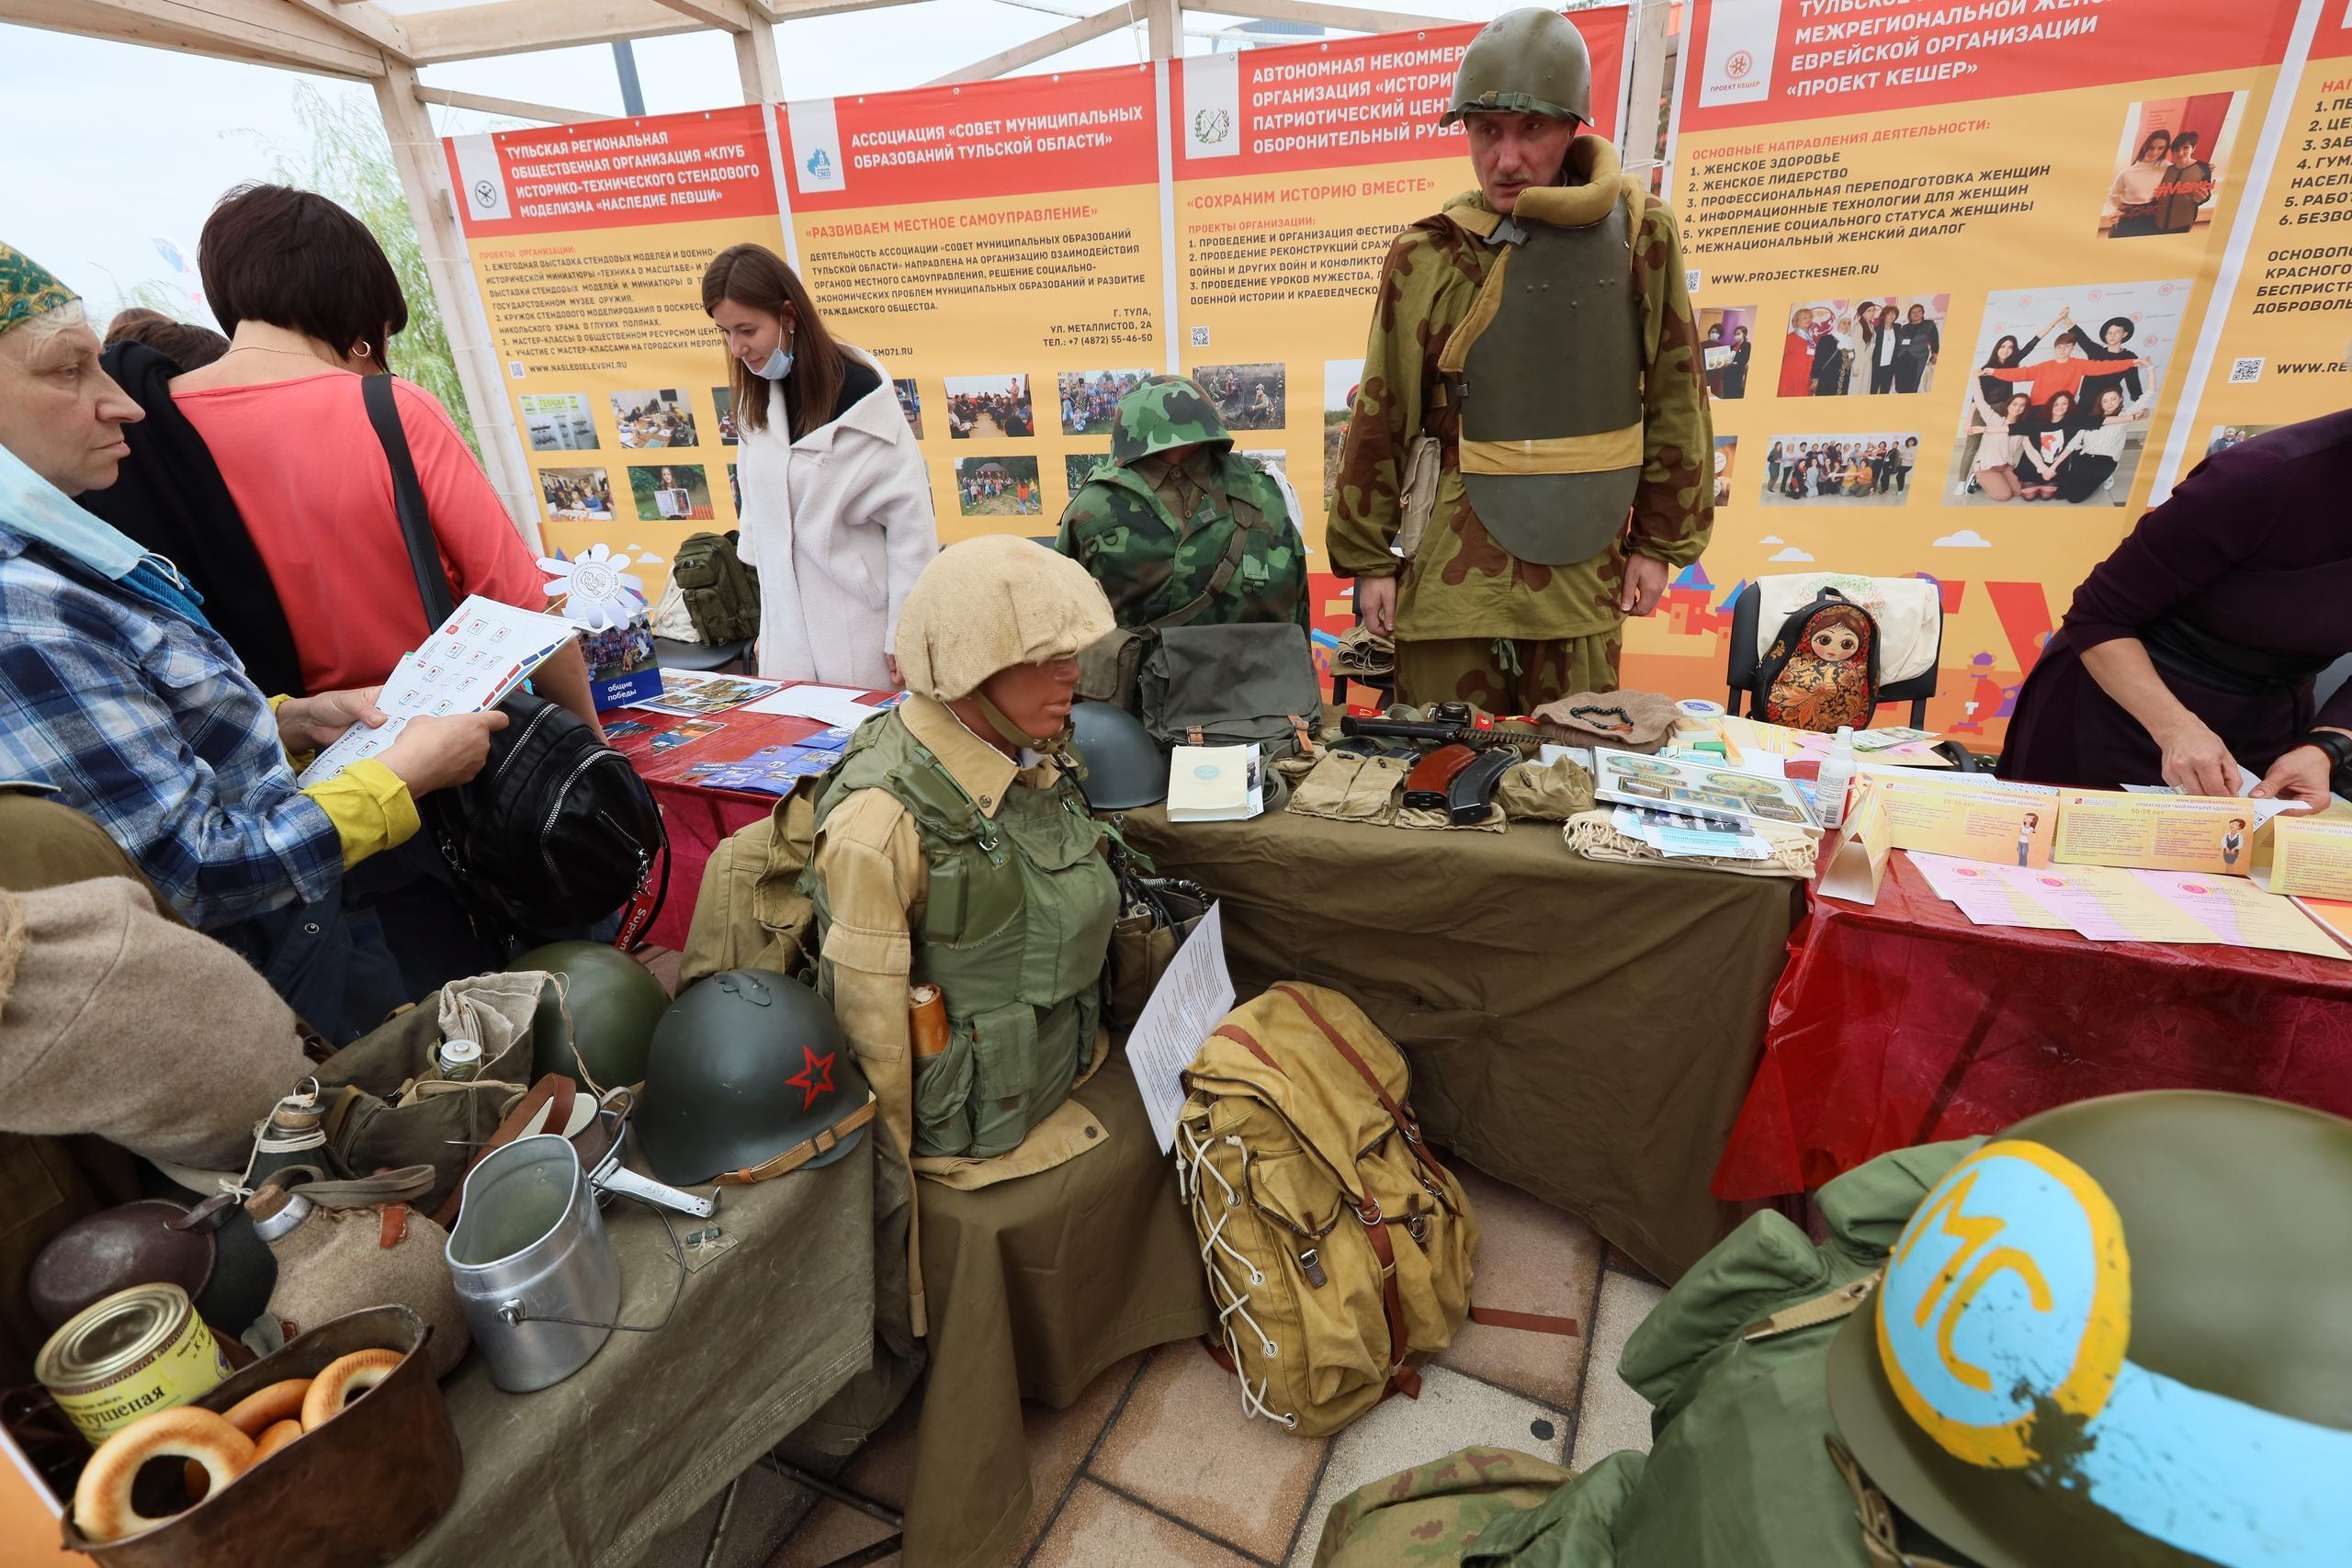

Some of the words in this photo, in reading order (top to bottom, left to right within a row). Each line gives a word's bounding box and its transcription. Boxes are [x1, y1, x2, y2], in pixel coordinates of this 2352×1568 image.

[1800, 0, 1909, 17] ТУЛЬСК
[1795, 0, 2025, 45] МЕЖРЕГИОНАЛЬНОЙ
[1791, 39, 1918, 72] ЕВРЕЙСКОЙ
[1926, 16, 2098, 54] ОРГАНИЗАЦИИ
[1253, 58, 1363, 83] АВТОНОМНАЯ
[1787, 73, 1879, 97] «ПРОЕКТ
[1886, 61, 1978, 85] КЕШЕР»
[1254, 82, 1370, 107] ОРГАНИЗАЦИЯ
[1710, 84, 1736, 92] ПРОЕКТ
[1737, 81, 1760, 89] КЕШЕР
[1254, 99, 1403, 130] ПАТРИОТИЧЕСКИЙ
[852, 126, 944, 147] АССОЦИАЦИЯ
[949, 120, 1001, 138] «СОВЕТ
[1007, 106, 1143, 131] МУНИЦИПАЛЬНЫХ
[505, 141, 569, 159] ТУЛЬСКАЯ
[571, 132, 668, 152] РЕГИОНАЛЬНАЯ
[854, 147, 954, 168] ОБРАЗОВАНИЙ
[958, 139, 1032, 159] ТУЛЬСКОЙ
[1037, 131, 1112, 151] ОБЛАСТИ»
[1254, 125, 1408, 152] ОБОРОНИТЕЛЬНЫЙ
[1691, 143, 1764, 161] ОСНОВНЫЕ
[1769, 133, 1867, 152] НАПРАВЛЕНИЯ
[1872, 119, 1990, 141] ДЕЯТЕЛЬНОСТИ:
[511, 159, 610, 179] ОБЩЕСТВЕННАЯ
[613, 150, 701, 169] ОРГАНИЗАЦИЯ
[1703, 159, 1766, 175] ЖЕНСКОЕ
[1770, 152, 1840, 168] ЗДОРОВЬЕ
[515, 174, 674, 197] ИСТОРИКО-ТЕХНИЧЕСКОГО
[678, 165, 760, 183] СТЕНДОВОГО
[1702, 175, 1764, 191] ЖЕНСКОЕ
[1768, 168, 1849, 185] ЛИДЕРСТВО
[1702, 186, 1839, 206] ПРОФЕССИОНАЛЬНАЯ
[1846, 173, 1973, 193] ПЕРЕПОДГОТОВКА
[1978, 164, 2052, 182] ЖЕНЩИН
[1188, 191, 1274, 209] «СОХРАНИМ
[1282, 184, 1355, 201] ИСТОРИЮ
[1363, 177, 1433, 195] ВМЕСТЕ»
[1701, 203, 1826, 221] ИНФОРМАЦИОННЫЕ
[1831, 194, 1920, 211] ТЕХНОЛОГИИ
[1924, 191, 1954, 204] ДЛЯ
[1958, 184, 2030, 201] ЖЕНЩИН
[520, 200, 594, 218] МОДЕЛИЗМА
[1697, 222, 1780, 238] УКРЕПЛЕНИЕ
[1784, 213, 1881, 231] СОЦИАЛЬНОГО
[1884, 208, 1946, 222] СТАТУСА
[1950, 200, 2034, 218] ЖЕНЩИНЫ
[805, 221, 889, 239] «РАЗВИВАЕМ
[894, 216, 955, 232] МЕСТНОЕ
[960, 206, 1098, 226] САМОУПРАВЛЕНИЕ»
[1188, 222, 1235, 234] ПРОЕКТЫ
[1239, 216, 1315, 231] ОРГАНИЗАЦИИ:
[809, 248, 876, 261] ДЕЯТЕЛЬНОСТЬ
[878, 243, 937, 256] АССОЦИАЦИИ
[940, 241, 973, 252] «СОВЕТ
[976, 234, 1059, 249] МУНИЦИПАЛЬНЫХ
[1062, 229, 1131, 243] ОБРАЗОВАНИЙ
[1200, 234, 1265, 248] ПРОВЕДЕНИЕ
[1279, 227, 1351, 242] ОРГАНИЗАЦИЯ
[1697, 234, 1832, 252] МЕЖНАЦИОНАЛЬНЫЙ
[1838, 227, 1905, 243] ЖЕНСКИЙ
[1908, 222, 1966, 237] ДИАЛОГ
[479, 250, 515, 260] ПРОЕКТЫ
[492, 260, 538, 271] ЕЖЕГОДНАЯ
[539, 257, 582, 268] ВЫСТАВКА
[582, 254, 631, 265] СТЕНДОВЫХ
[632, 251, 671, 261] МОДЕЛЕЙ
[680, 247, 717, 258] ВОЕННО-
[811, 264, 855, 276] ТУЛЬСКОЙ
[858, 261, 901, 272] ОБЛАСТИ»
[904, 256, 963, 269] НАПРАВЛЕНА
[980, 251, 1047, 264] ОРГАНИЗАЦИЮ
[1051, 243, 1139, 259] ВЗАИМОДЕЙСТВИЯ
[1201, 248, 1266, 262] ПРОВЕДЕНИЕ
[1271, 242, 1357, 256] РЕКОНСТРУКЦИЙ
[1362, 239, 1392, 250] СРАЖ
[813, 278, 852, 288] ОРГАНОВ
[854, 276, 898, 286] МЕСТНОГО
[900, 270, 986, 283] САМОУПРАВЛЕНИЯ,
[989, 266, 1033, 277] РЕШЕНИЕ
[1036, 263, 1096, 275] СОЦИАЛЬНО-
[1190, 265, 1225, 277] ВОЙНЫ
[1238, 262, 1275, 274] ДРУГИХ
[1280, 260, 1306, 271] ВОЙН
[1320, 254, 1385, 268] КОНФЛИКТО
[1712, 265, 1878, 284] WWW.PROJECTKESHER.RU
[2265, 264, 2352, 279] КРАСНОГО
[815, 290, 888, 302] ЭКОНОМИЧЕСКИХ
[891, 288, 933, 298] ПРОБЛЕМ
[935, 282, 1015, 295] МУНИЦИПАЛЬНЫХ
[1019, 277, 1084, 290] ОБРАЗОВАНИЙ
[1097, 274, 1146, 286] РАЗВИТИЕ
[1202, 277, 1266, 290] ПРОВЕДЕНИЕ
[1271, 275, 1308, 286] УРОКОВ
[1313, 270, 1373, 283] МУЖЕСТВА,
[492, 299, 566, 310] ГОСУДАРСТВЕННОМ
[570, 297, 594, 306] МУЗЕЕ
[888, 301, 938, 312] ОБЩЕСТВА.
[1191, 294, 1235, 305] ВОЕННОЙ
[1239, 291, 1283, 302] ИСТОРИИ
[1298, 285, 1377, 299] КРАЕВЕДЧЕСКО
[503, 312, 535, 321] КРУЖОК
[537, 310, 585, 320] СТЕНДОВОГО
[586, 305, 654, 316] МОДЕЛИРОВАНИЯ
[1114, 309, 1120, 317] Г.
[1125, 308, 1150, 317] ТУЛА,
[498, 324, 551, 334] НИКОЛЬСКОГО
[554, 322, 579, 332] ХРАМА
[590, 321, 618, 329] ГЛУХИХ
[512, 335, 575, 345] МАСТЕР-КЛАССЫ
[583, 331, 647, 342] ОБЩЕСТВЕННОМ
[649, 328, 695, 338] РЕСУРСНОМ
[1050, 325, 1065, 333] УЛ.
[1068, 321, 1136, 333] МЕТАЛЛИСТОВ,
[1140, 321, 1152, 329] 2А
[1043, 338, 1065, 347] ТЕЛ.:
[1069, 337, 1078, 345] +7
[1081, 336, 1108, 345] (4872)
[1112, 333, 1152, 344] 55-46-50
[2277, 362, 2349, 375] WWW.RE
[607, 681, 633, 693] общие
[607, 689, 637, 702] победы
[81, 1385, 165, 1427] тушеная
